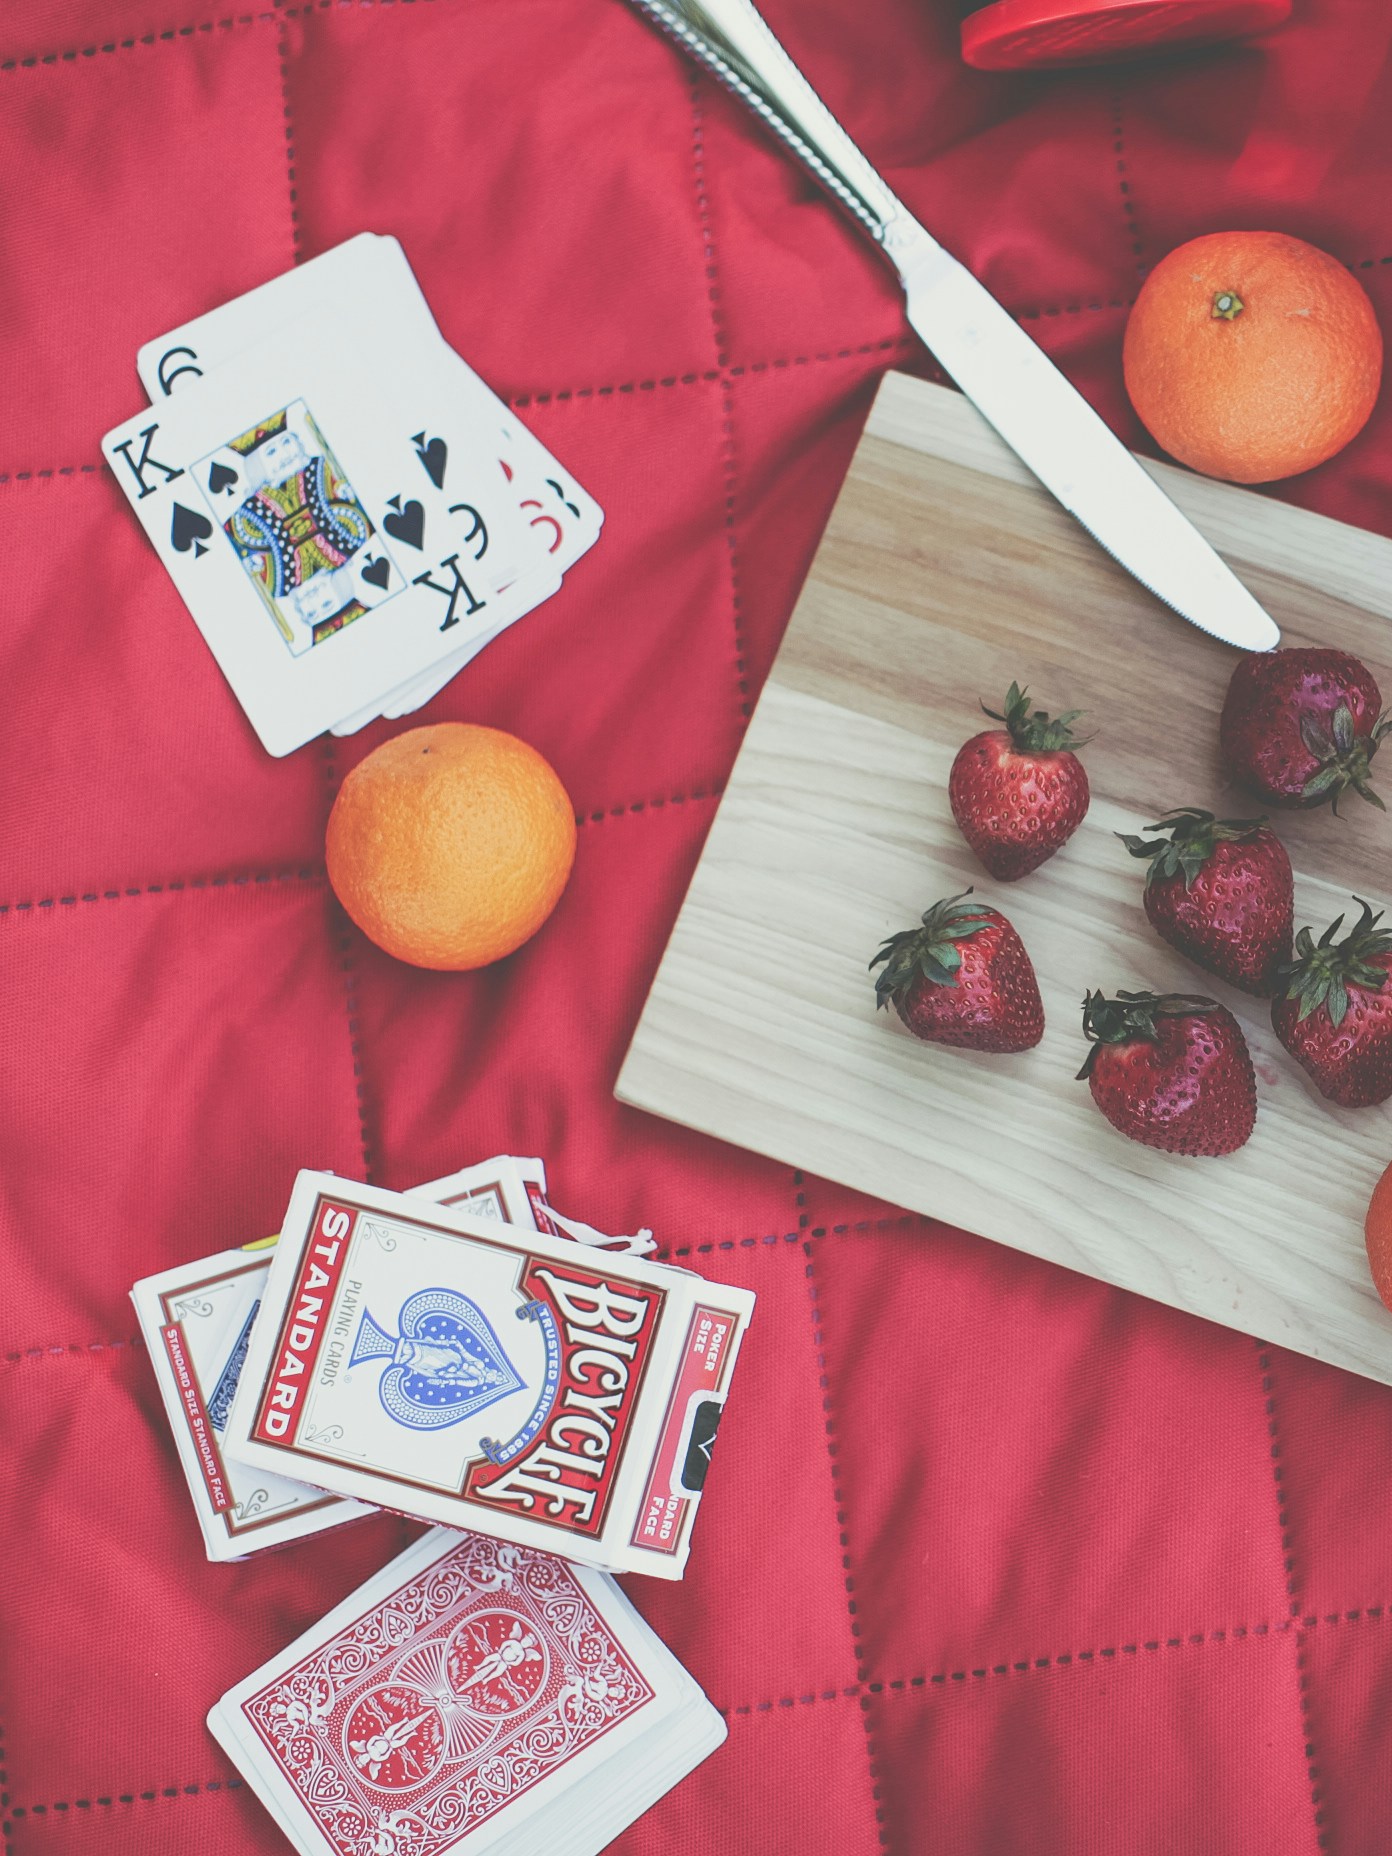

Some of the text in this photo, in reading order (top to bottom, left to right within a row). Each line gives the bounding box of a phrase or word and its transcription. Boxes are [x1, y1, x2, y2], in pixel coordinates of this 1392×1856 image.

[113, 423, 185, 500] K
[412, 553, 487, 632] K
[265, 1207, 350, 1437] STANDARD
[320, 1280, 362, 1387] PLAYING CARDS
[693, 1319, 712, 1354] SIZE
[704, 1323, 727, 1372] POKER
[167, 1328, 226, 1507] STANDARD SIZE STANDARD FACE
[476, 1269, 648, 1521] BICYCLE
[500, 1308, 558, 1461] TRUSTED SINCE 1885
[644, 1496, 665, 1537] FACE
